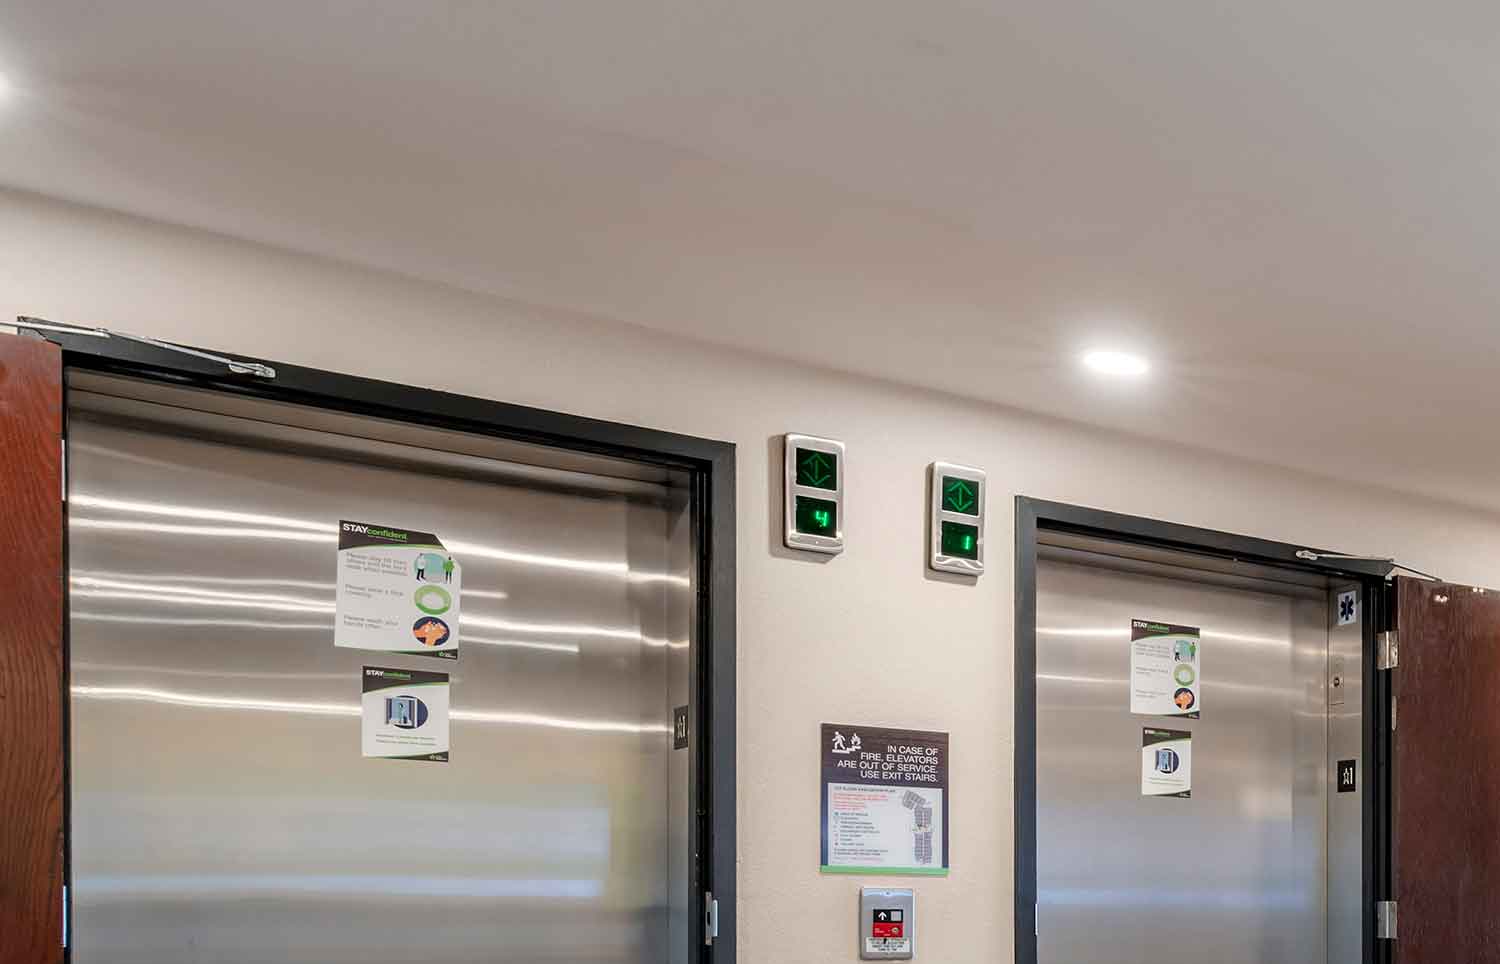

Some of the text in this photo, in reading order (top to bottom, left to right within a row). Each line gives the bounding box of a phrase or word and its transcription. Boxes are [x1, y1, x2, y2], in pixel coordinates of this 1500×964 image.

[965, 535, 971, 550] 1
[887, 745, 938, 756] IN CASE OF
[860, 752, 938, 765] FIRE, ELEVATORS
[837, 760, 938, 774] ARE OUT OF SERVICE.
[860, 770, 938, 782] USE EXIT STAIRS.
